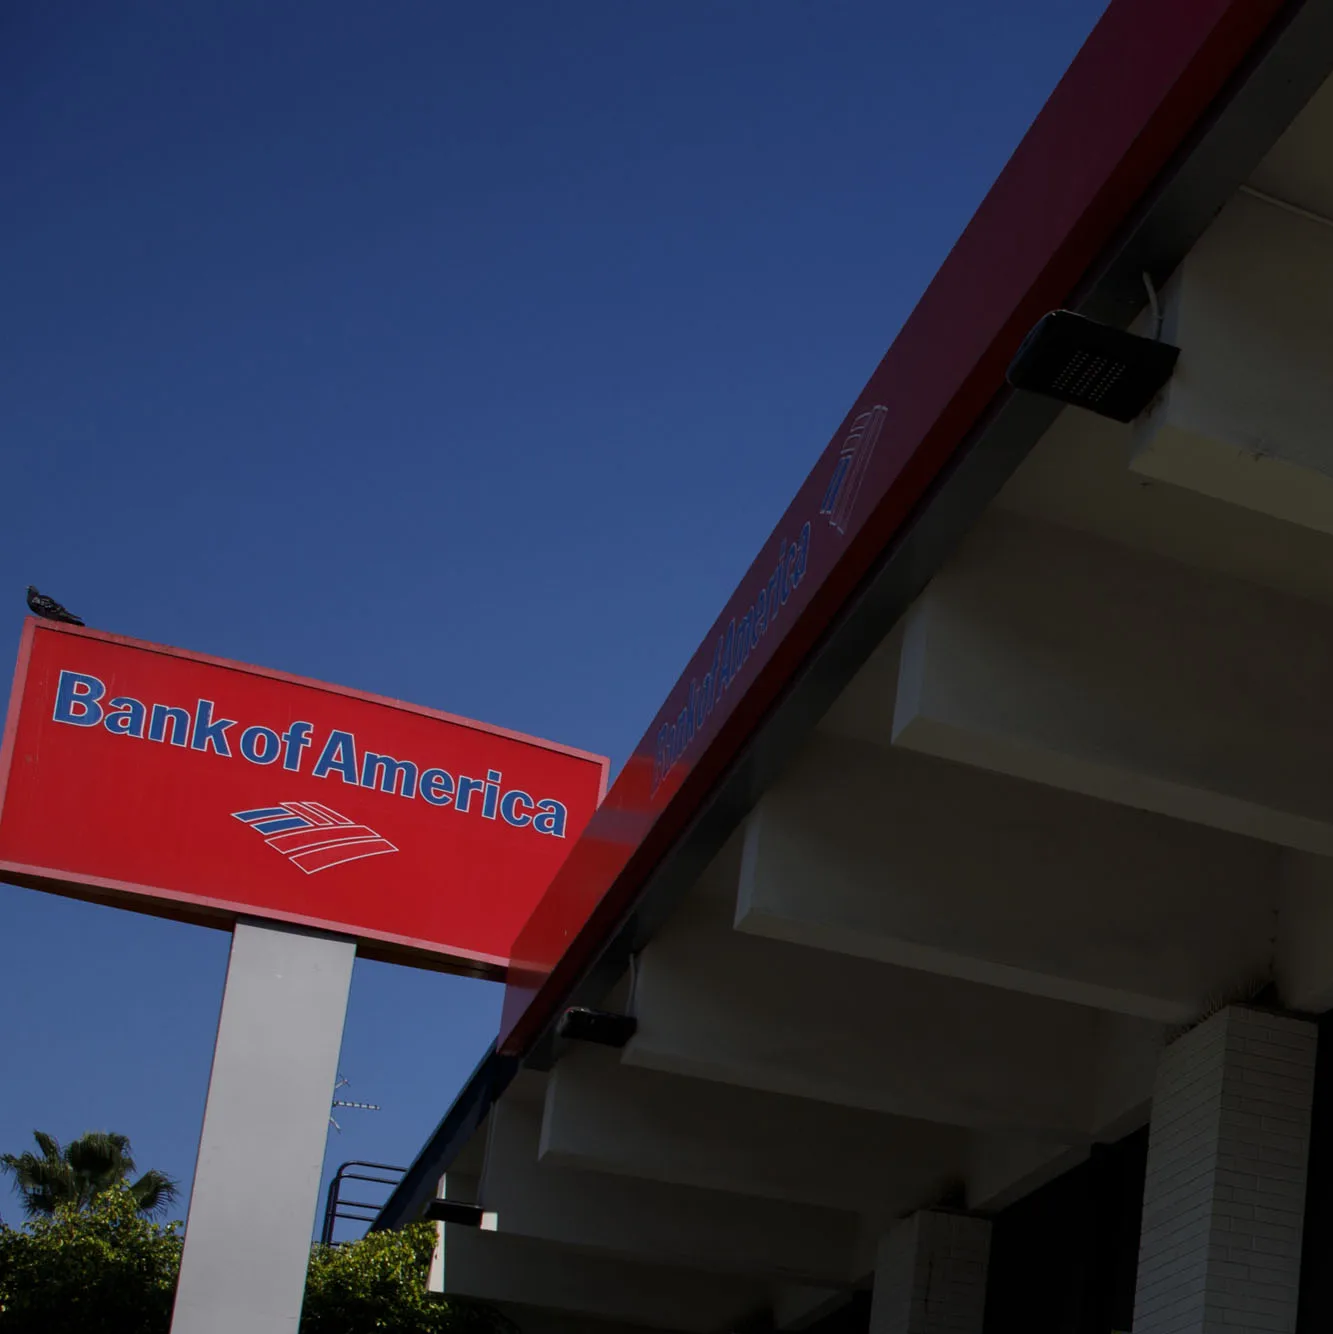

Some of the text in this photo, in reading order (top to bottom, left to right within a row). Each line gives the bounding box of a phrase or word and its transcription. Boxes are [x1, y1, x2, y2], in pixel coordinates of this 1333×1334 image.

[721, 520, 811, 689] America
[52, 670, 567, 838] Bank of America
